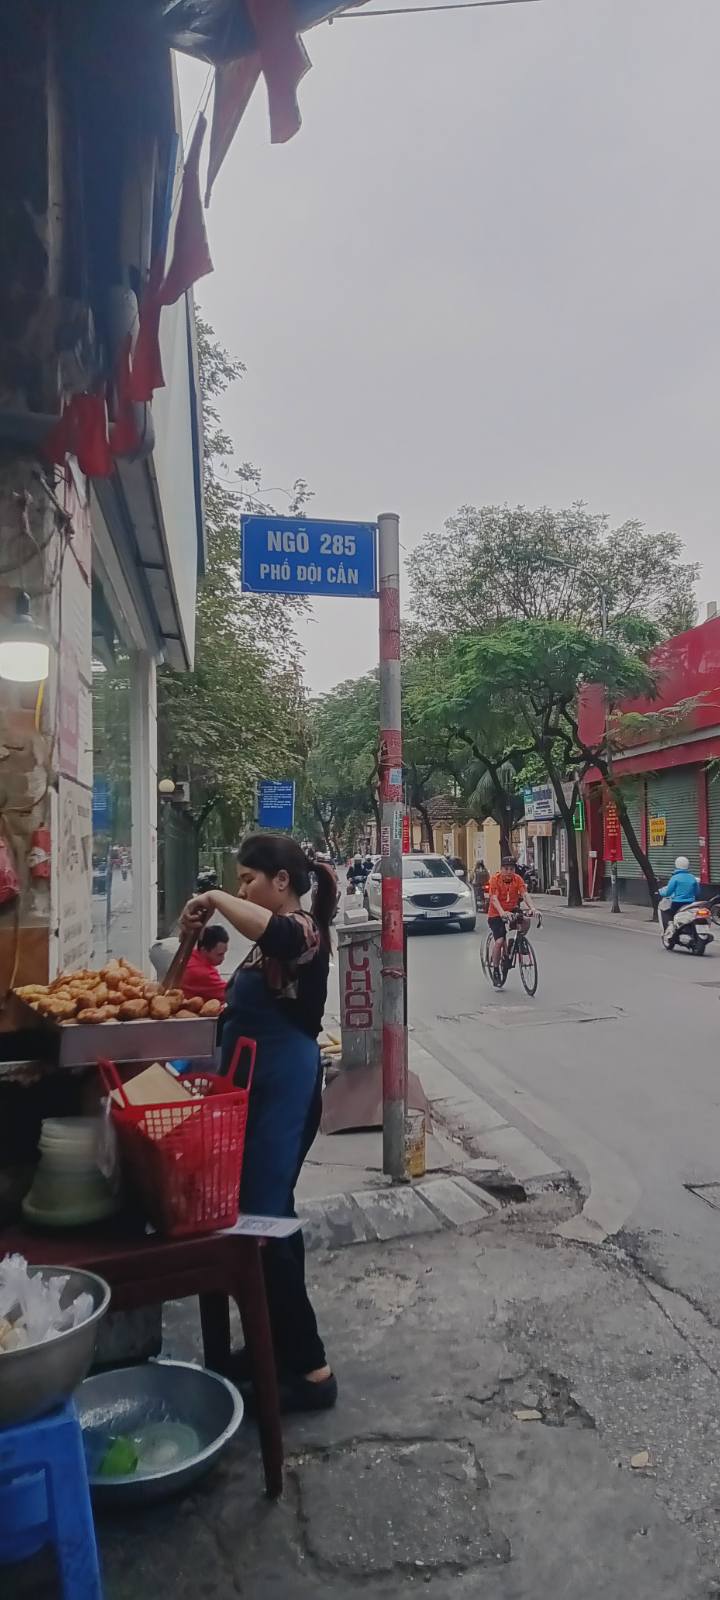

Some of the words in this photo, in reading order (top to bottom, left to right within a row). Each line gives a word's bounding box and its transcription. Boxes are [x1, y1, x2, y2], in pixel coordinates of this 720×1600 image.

[267, 528, 309, 553] NGÕ
[320, 534, 356, 556] 285
[260, 557, 291, 580] PHỐ
[296, 563, 321, 585] ĐỘI
